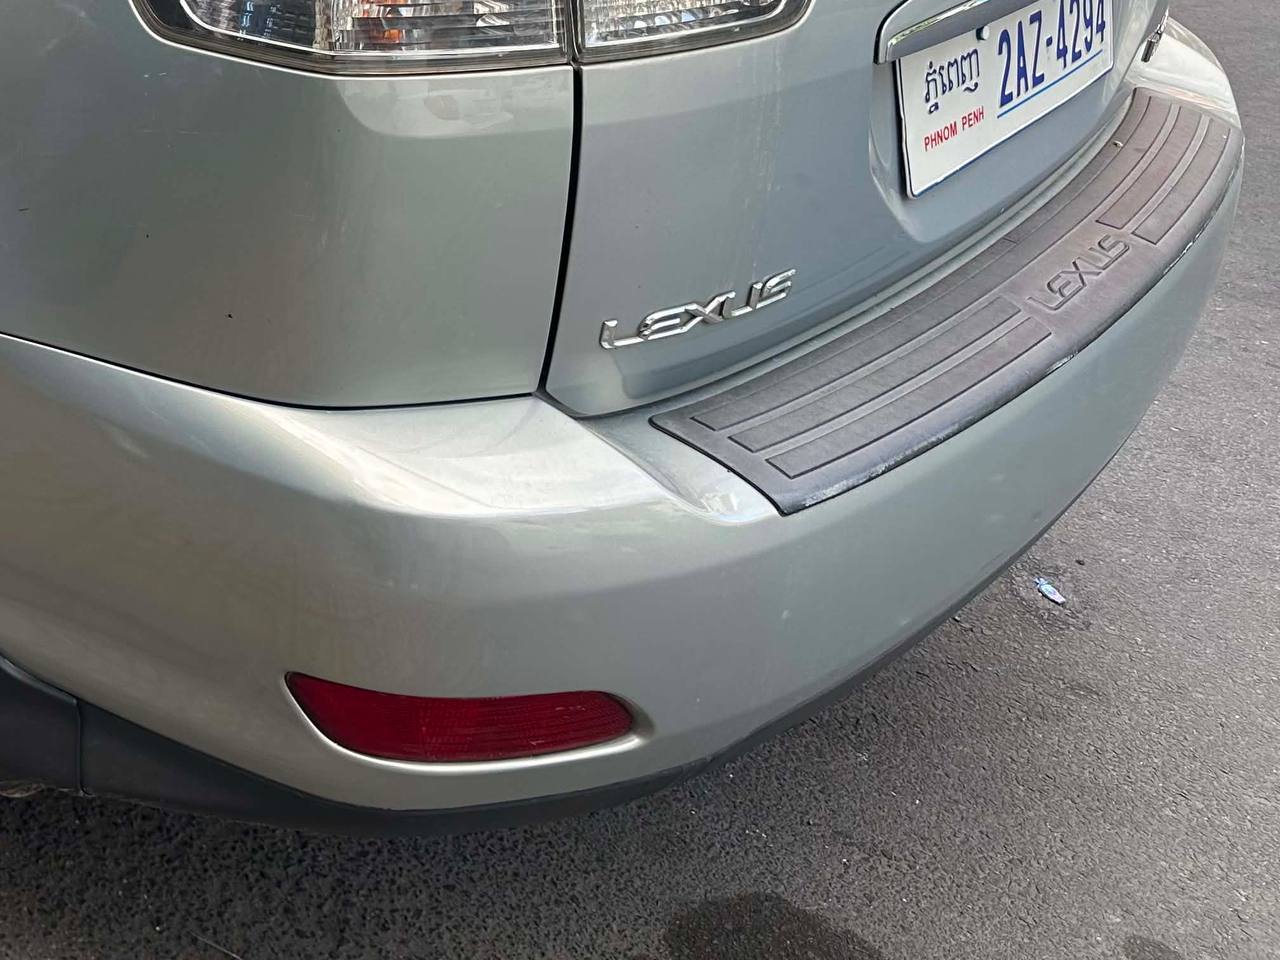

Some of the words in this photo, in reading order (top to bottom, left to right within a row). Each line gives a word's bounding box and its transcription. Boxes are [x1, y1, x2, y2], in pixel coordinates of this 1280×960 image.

[924, 48, 980, 115] ភ្នំពេញ
[923, 121, 957, 152] PHNOM
[961, 106, 985, 133] PENH
[1027, 234, 1130, 311] LEXUS
[600, 268, 797, 350] LEXUS
